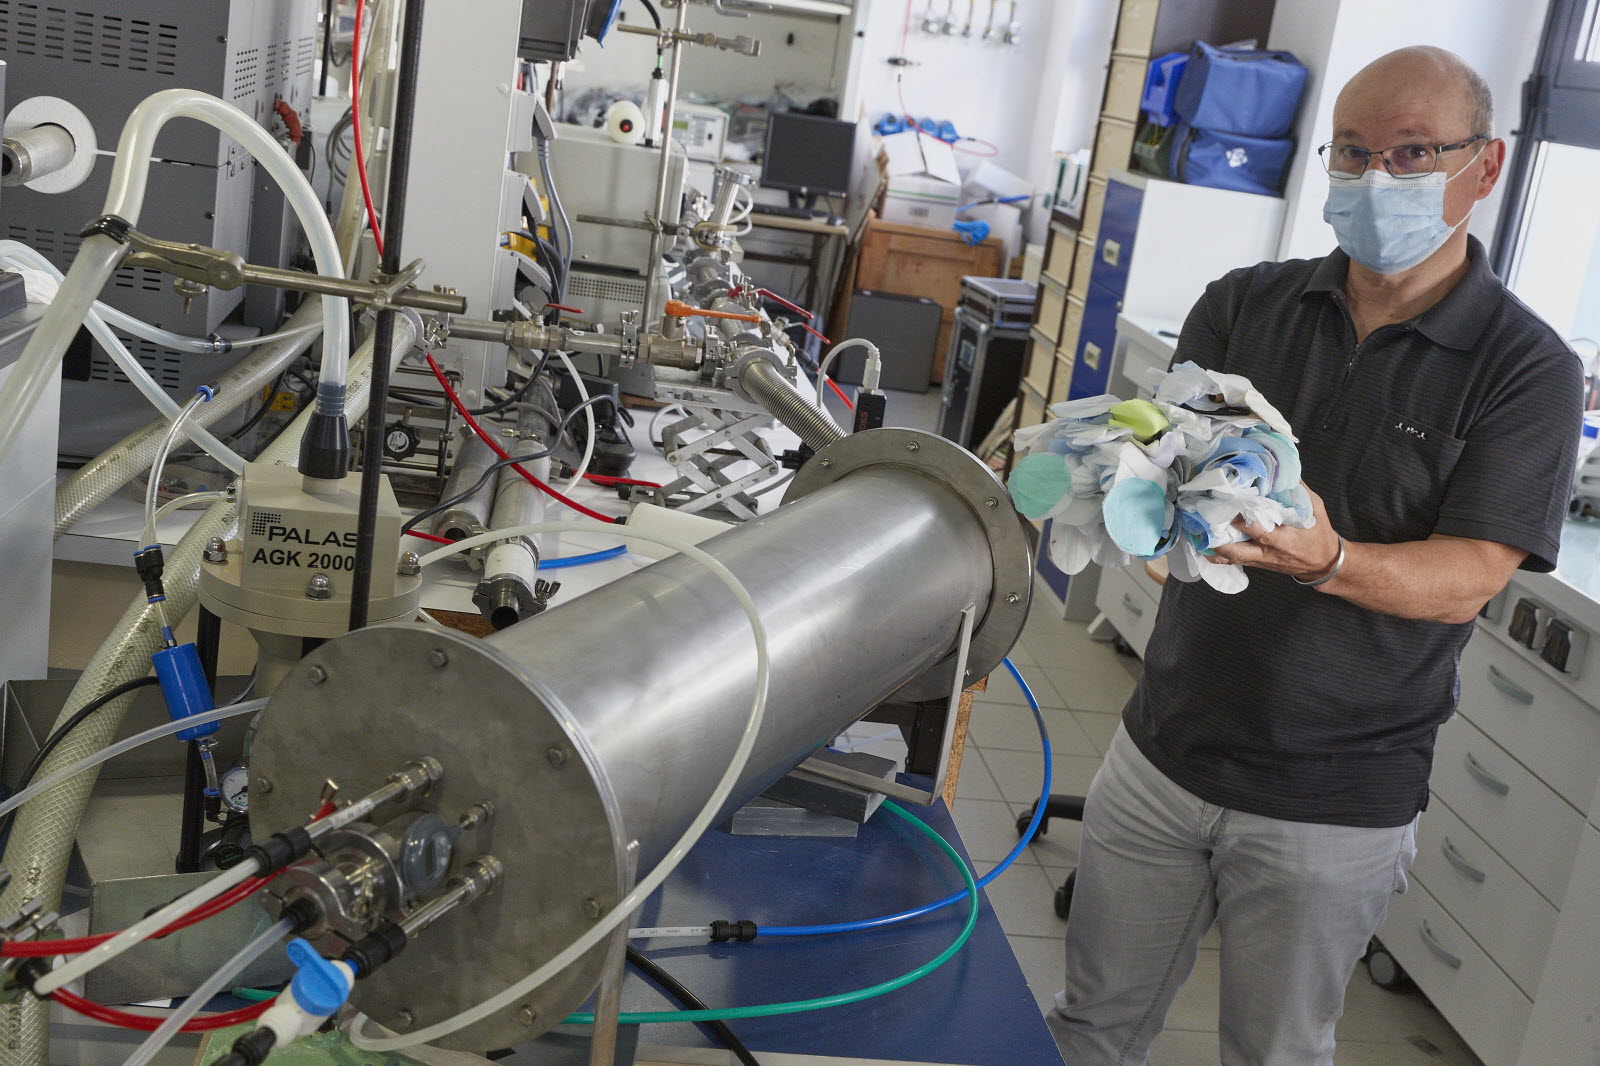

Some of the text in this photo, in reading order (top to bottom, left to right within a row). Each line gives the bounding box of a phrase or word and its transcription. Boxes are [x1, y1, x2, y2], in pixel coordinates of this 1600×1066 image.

[268, 526, 358, 548] PALAS
[252, 548, 355, 572] AGK 2000
